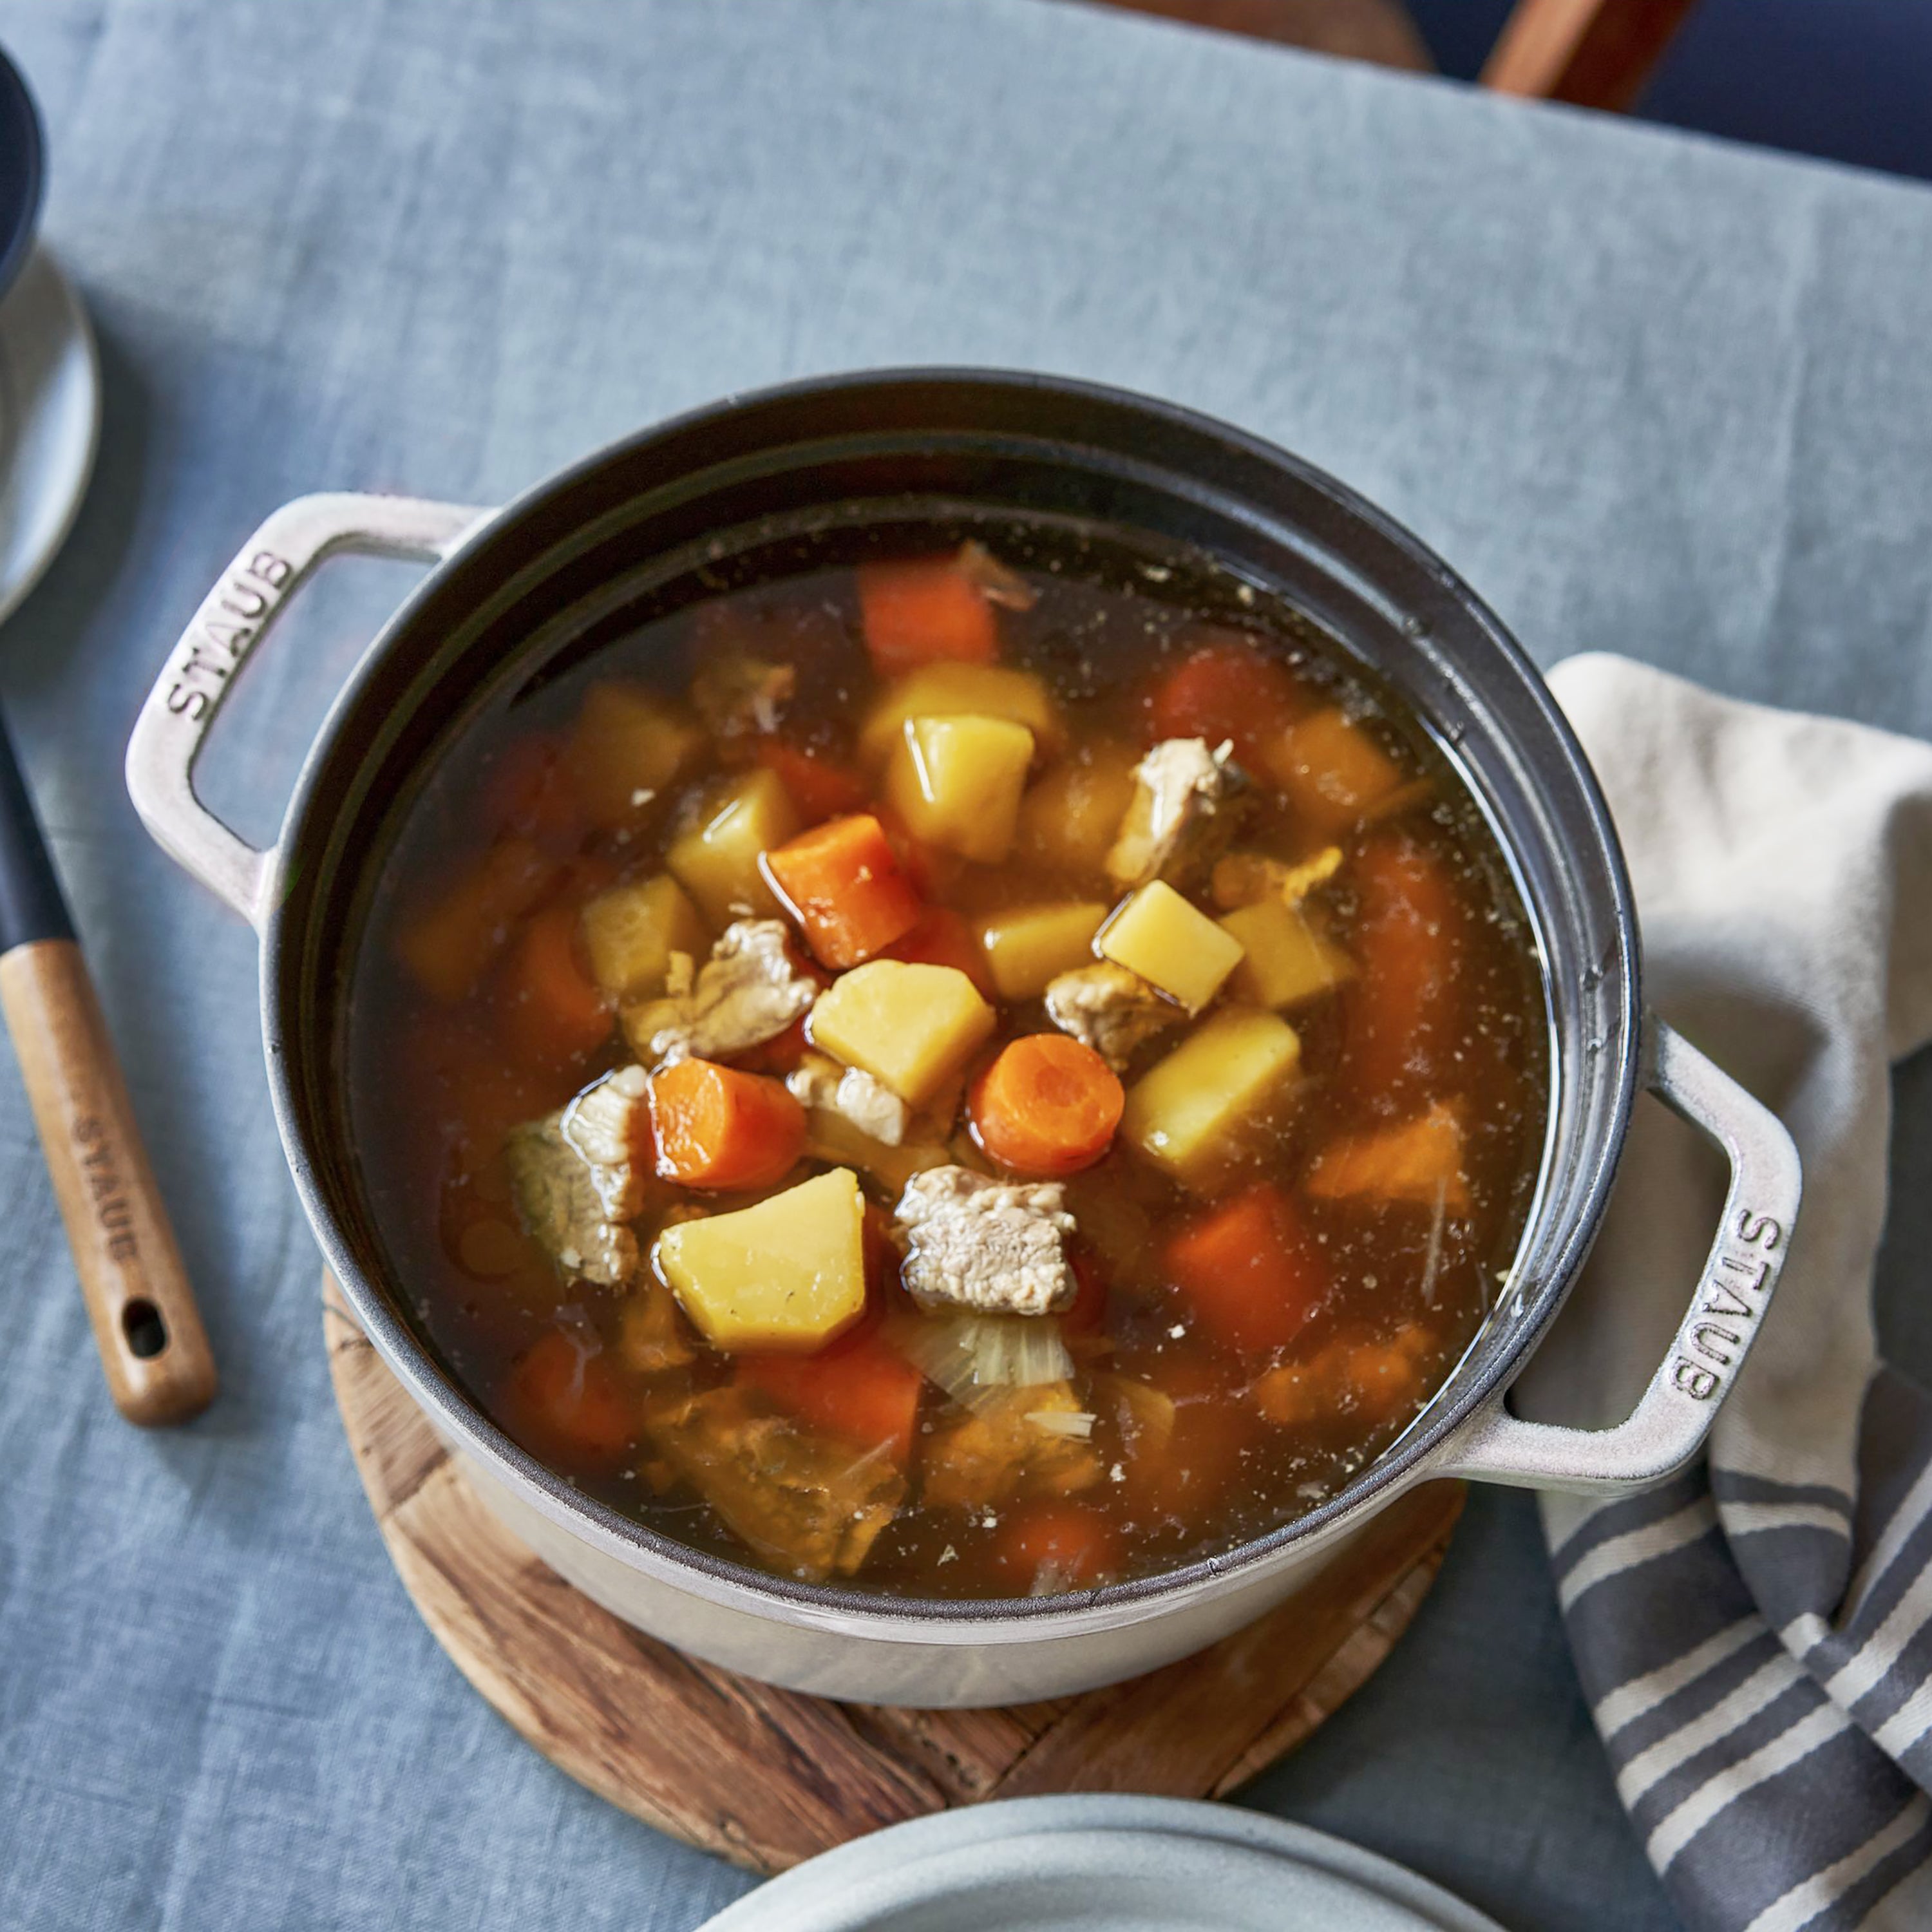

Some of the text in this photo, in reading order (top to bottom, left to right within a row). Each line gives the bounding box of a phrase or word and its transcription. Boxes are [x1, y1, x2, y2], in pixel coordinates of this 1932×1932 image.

[168, 551, 293, 721] STAUB
[72, 1117, 138, 1260] STAUB
[1669, 1208, 1781, 1400] STAUB
